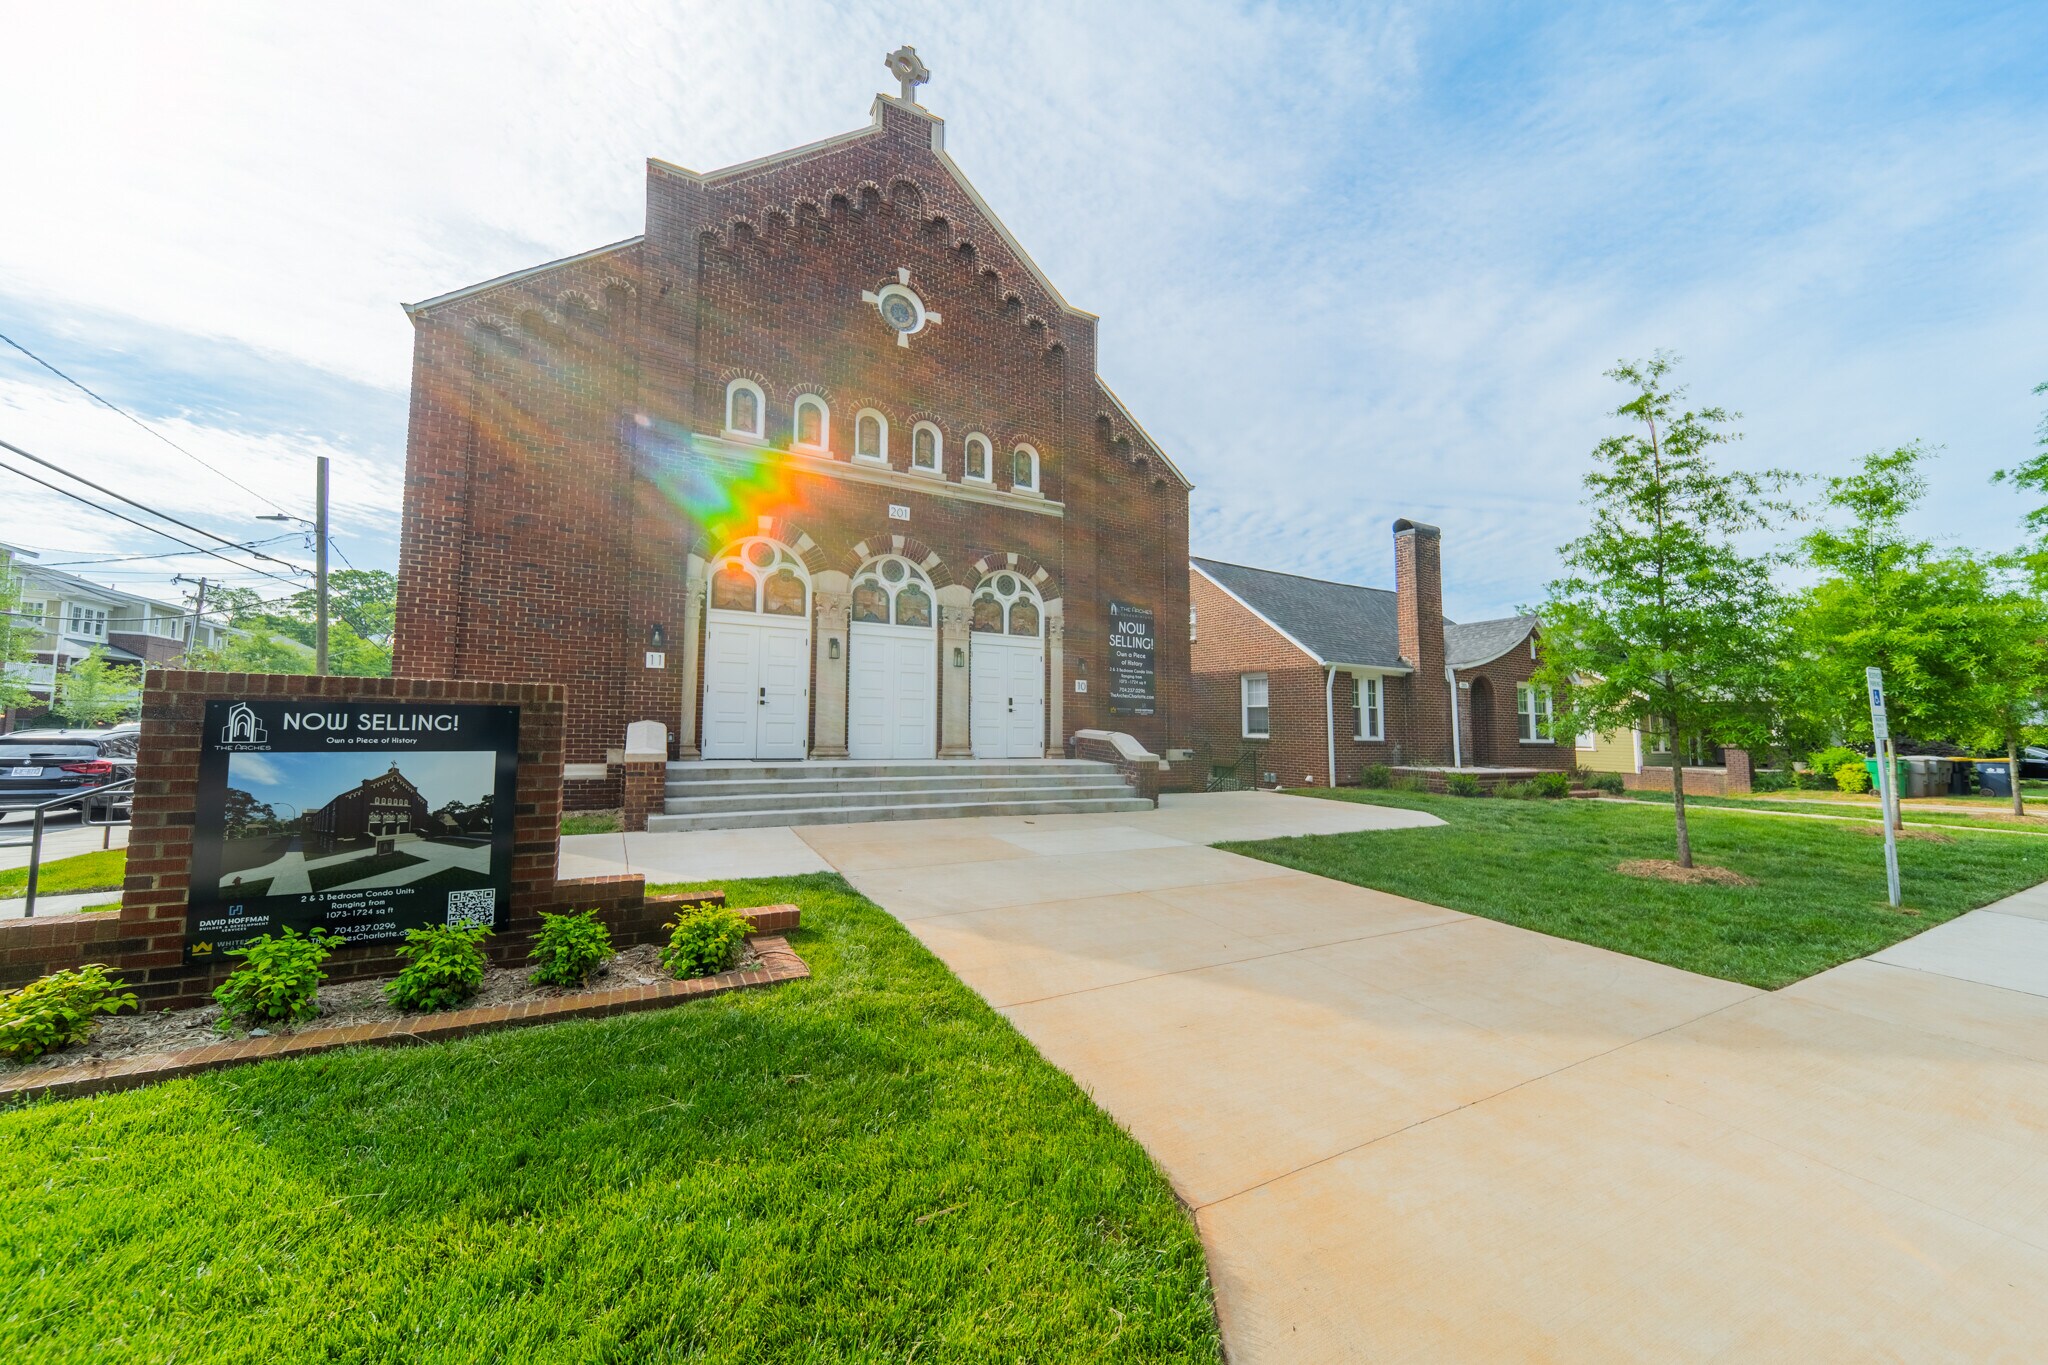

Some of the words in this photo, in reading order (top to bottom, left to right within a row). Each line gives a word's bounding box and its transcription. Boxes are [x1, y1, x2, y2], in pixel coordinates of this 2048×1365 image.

[890, 506, 907, 519] 201
[1118, 621, 1145, 635] NOW
[1109, 634, 1154, 650] SELLING!
[650, 654, 662, 666] 11
[1077, 681, 1086, 691] 10
[283, 712, 348, 731] NOW
[357, 713, 459, 731] SELLING!
[326, 736, 345, 744] Own
[356, 736, 379, 744] Piece
[381, 736, 390, 744] of
[391, 737, 418, 745] History
[300, 895, 307, 903] 2
[309, 894, 316, 902] &
[327, 892, 363, 901] Bedroom
[365, 889, 394, 898] Condo
[331, 900, 366, 909] Ranging
[326, 908, 373, 919] 1073-1724
[199, 919, 227, 927] DAVID
[228, 915, 270, 925] HOFFMAN
[229, 921, 269, 929] DEVELOPMENT
[333, 922, 396, 935] 704.237.0296
